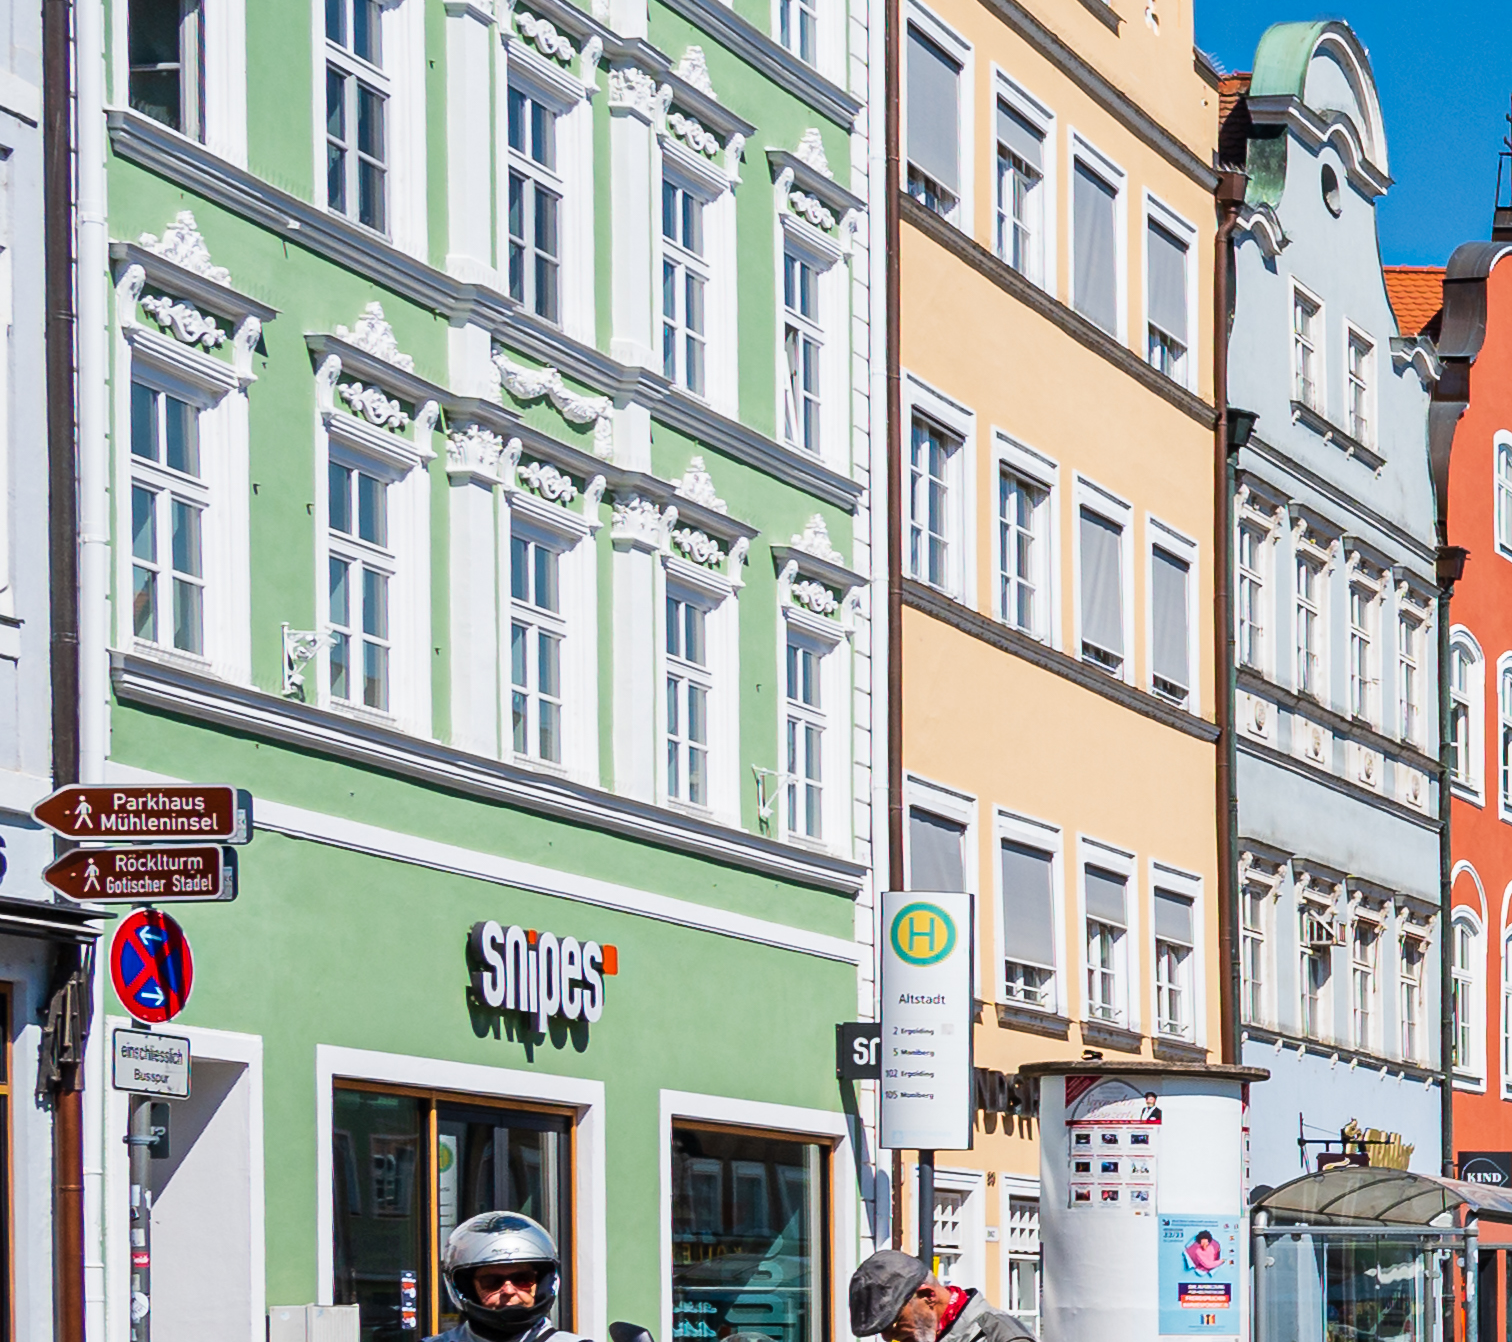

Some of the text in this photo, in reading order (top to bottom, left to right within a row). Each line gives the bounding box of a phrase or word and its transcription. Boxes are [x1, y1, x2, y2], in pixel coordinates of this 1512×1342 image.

[113, 793, 205, 811] Parkhaus
[100, 813, 219, 831] Mühleninsel
[115, 854, 203, 872] Röcklturm
[106, 874, 213, 893] Gotischer Stadel
[482, 920, 604, 1033] snipes
[898, 993, 946, 1005] Altstadt
[892, 1026, 899, 1035] 2
[892, 1048, 899, 1057] 5
[133, 1068, 170, 1085] Busspur
[1466, 1171, 1503, 1184] KIND
